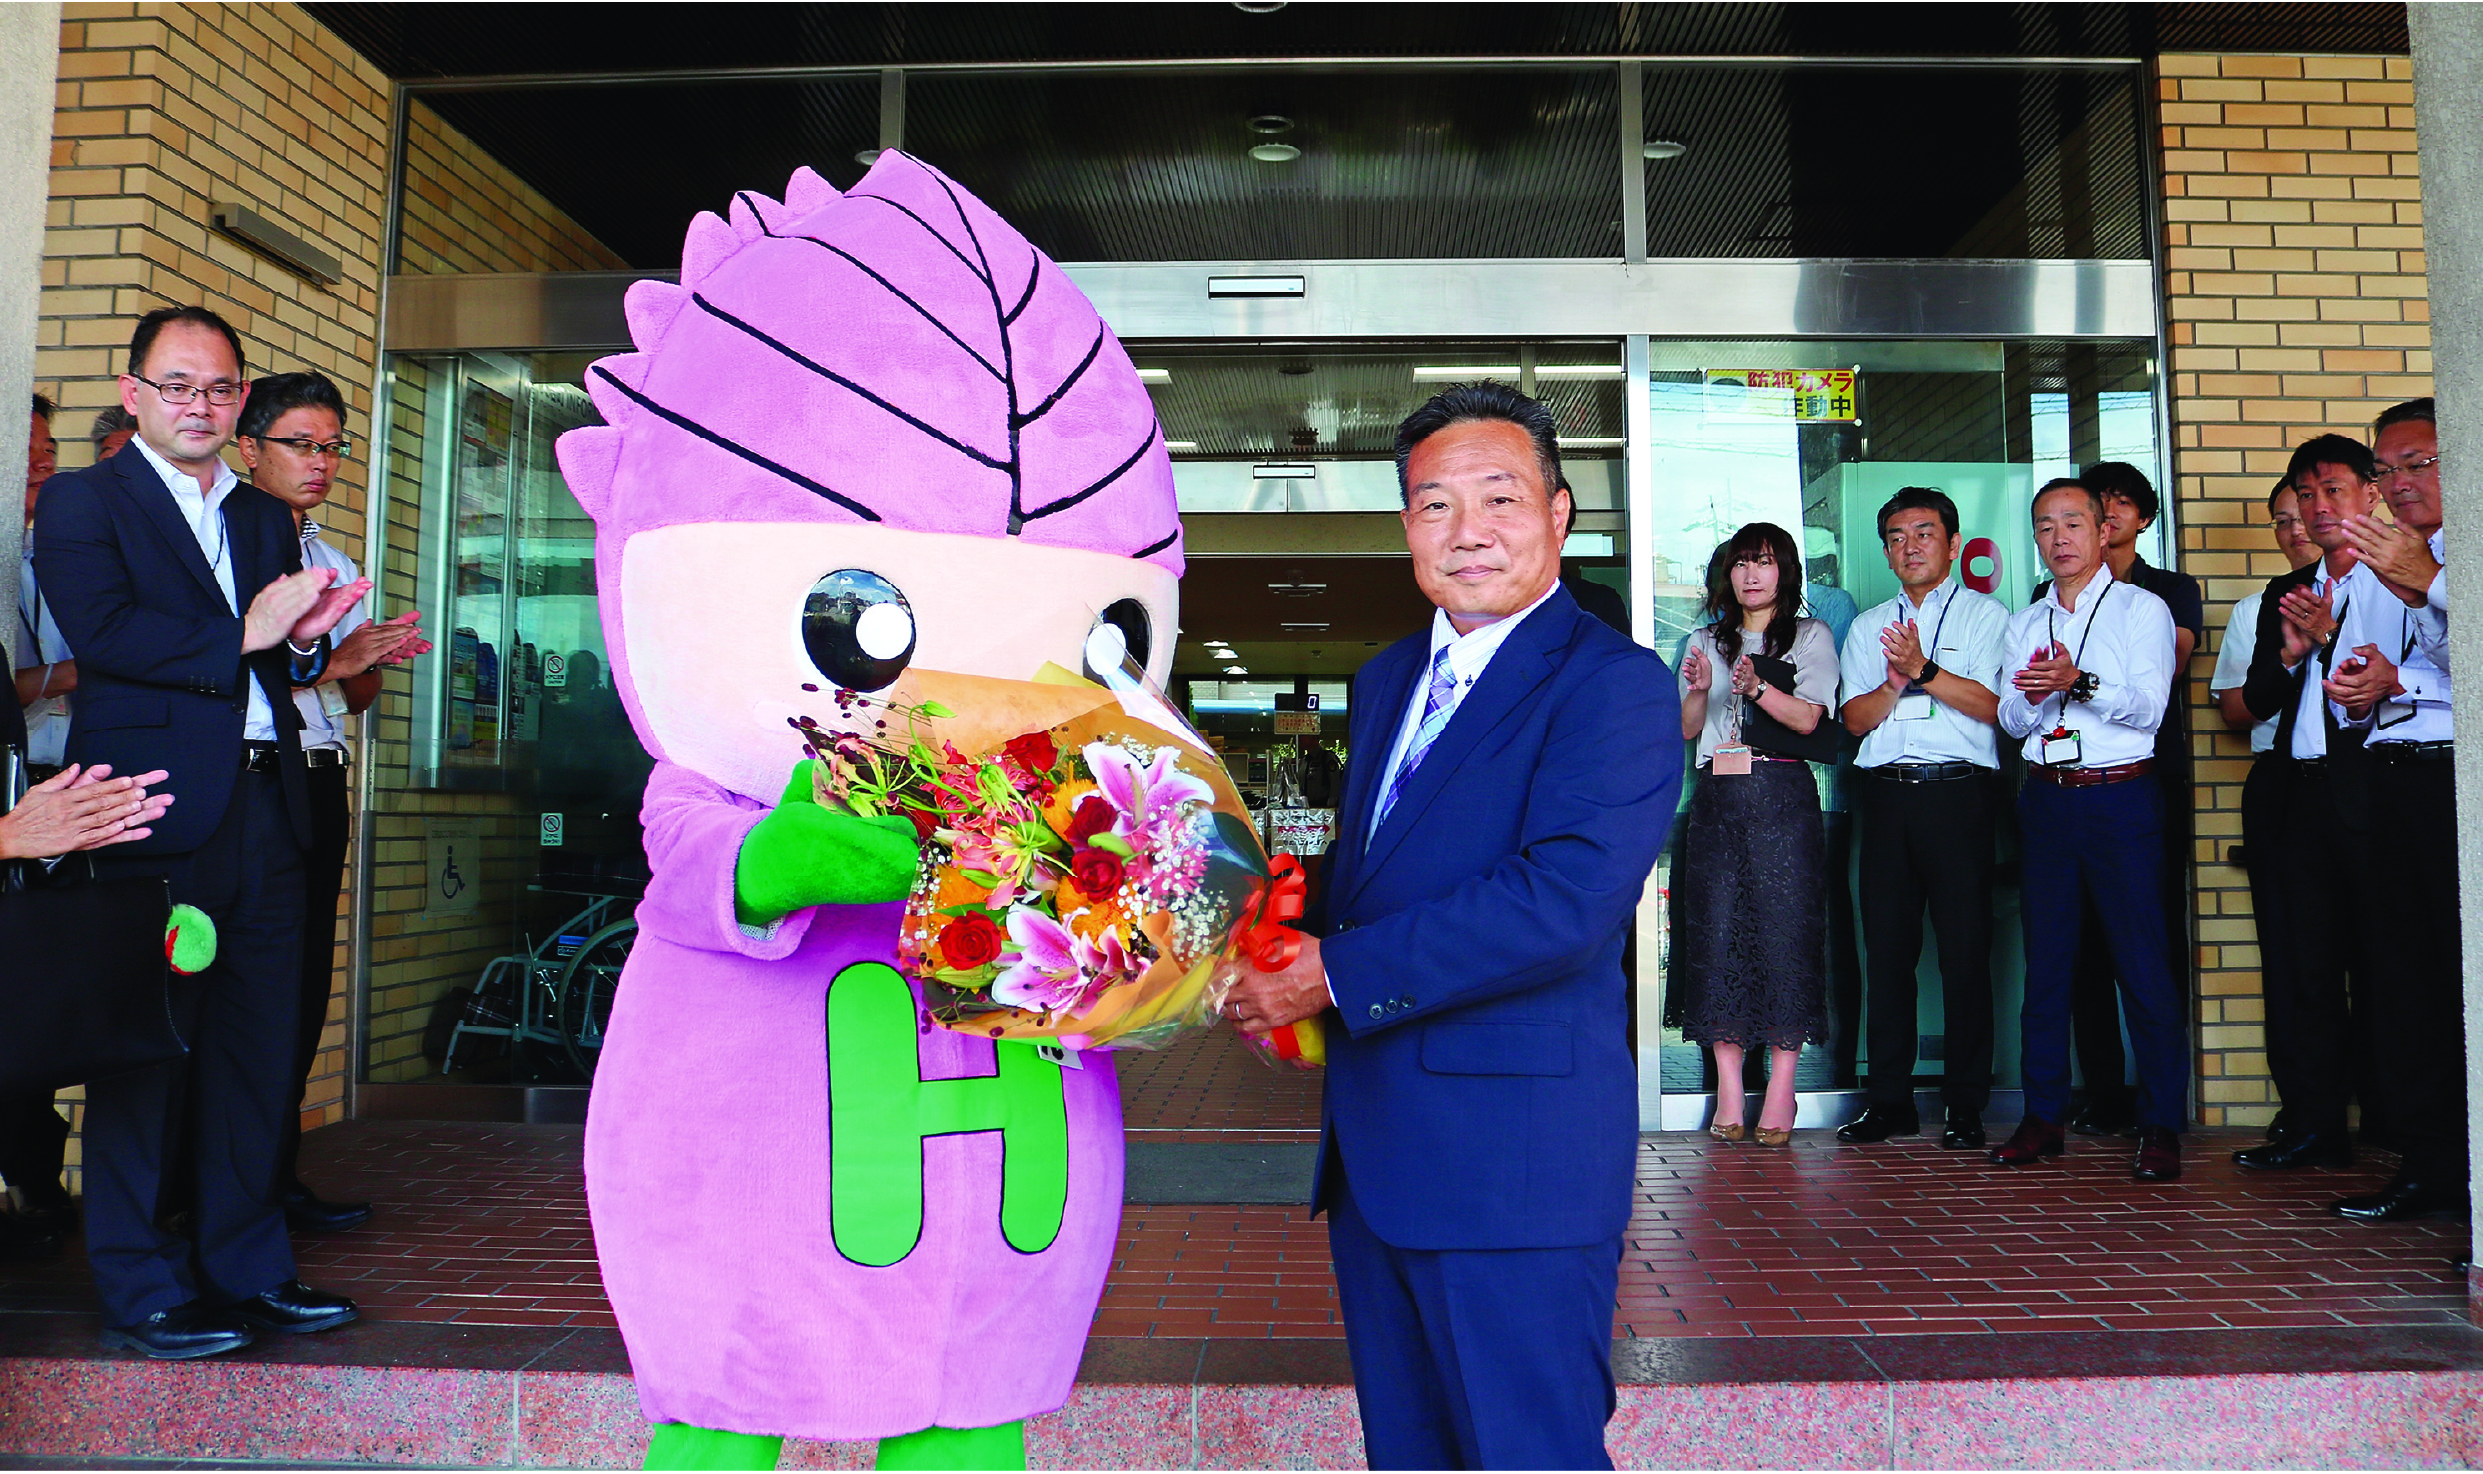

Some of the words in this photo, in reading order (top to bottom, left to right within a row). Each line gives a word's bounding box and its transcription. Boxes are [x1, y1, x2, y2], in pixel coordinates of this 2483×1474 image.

[1749, 371, 1851, 392] 防犯カメラ
[1307, 696, 1317, 709] 0
[826, 960, 1069, 1267] H
